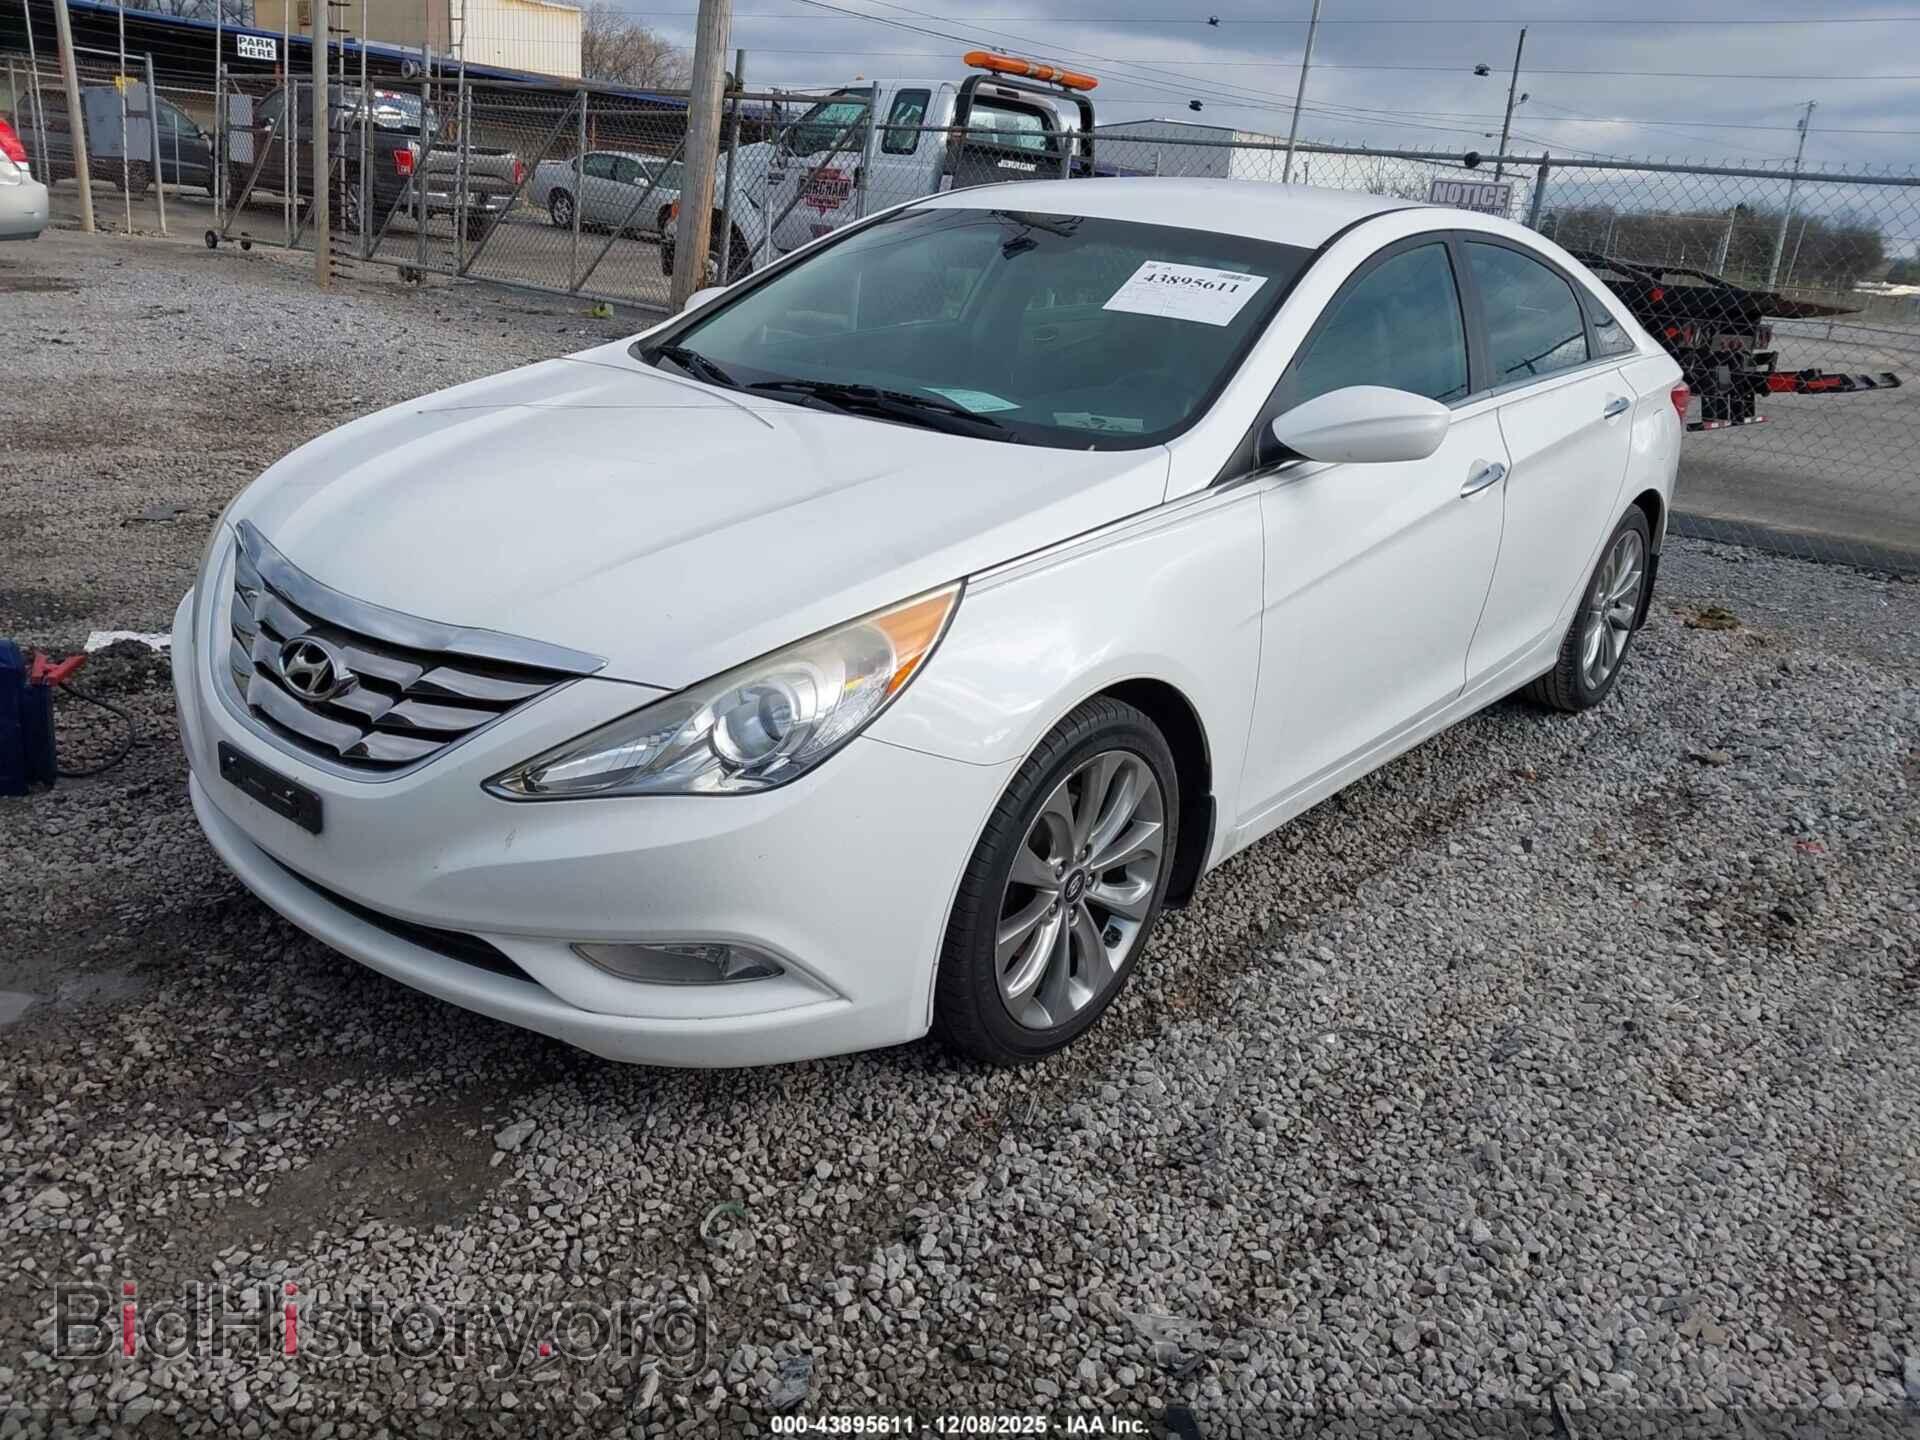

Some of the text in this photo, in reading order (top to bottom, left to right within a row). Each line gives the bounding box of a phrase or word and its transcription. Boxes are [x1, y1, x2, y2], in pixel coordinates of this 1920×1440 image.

[239, 36, 274, 48] PARK
[240, 47, 274, 58] HERE
[1432, 182, 1508, 207] NOTICE
[1144, 273, 1239, 293] 43895611
